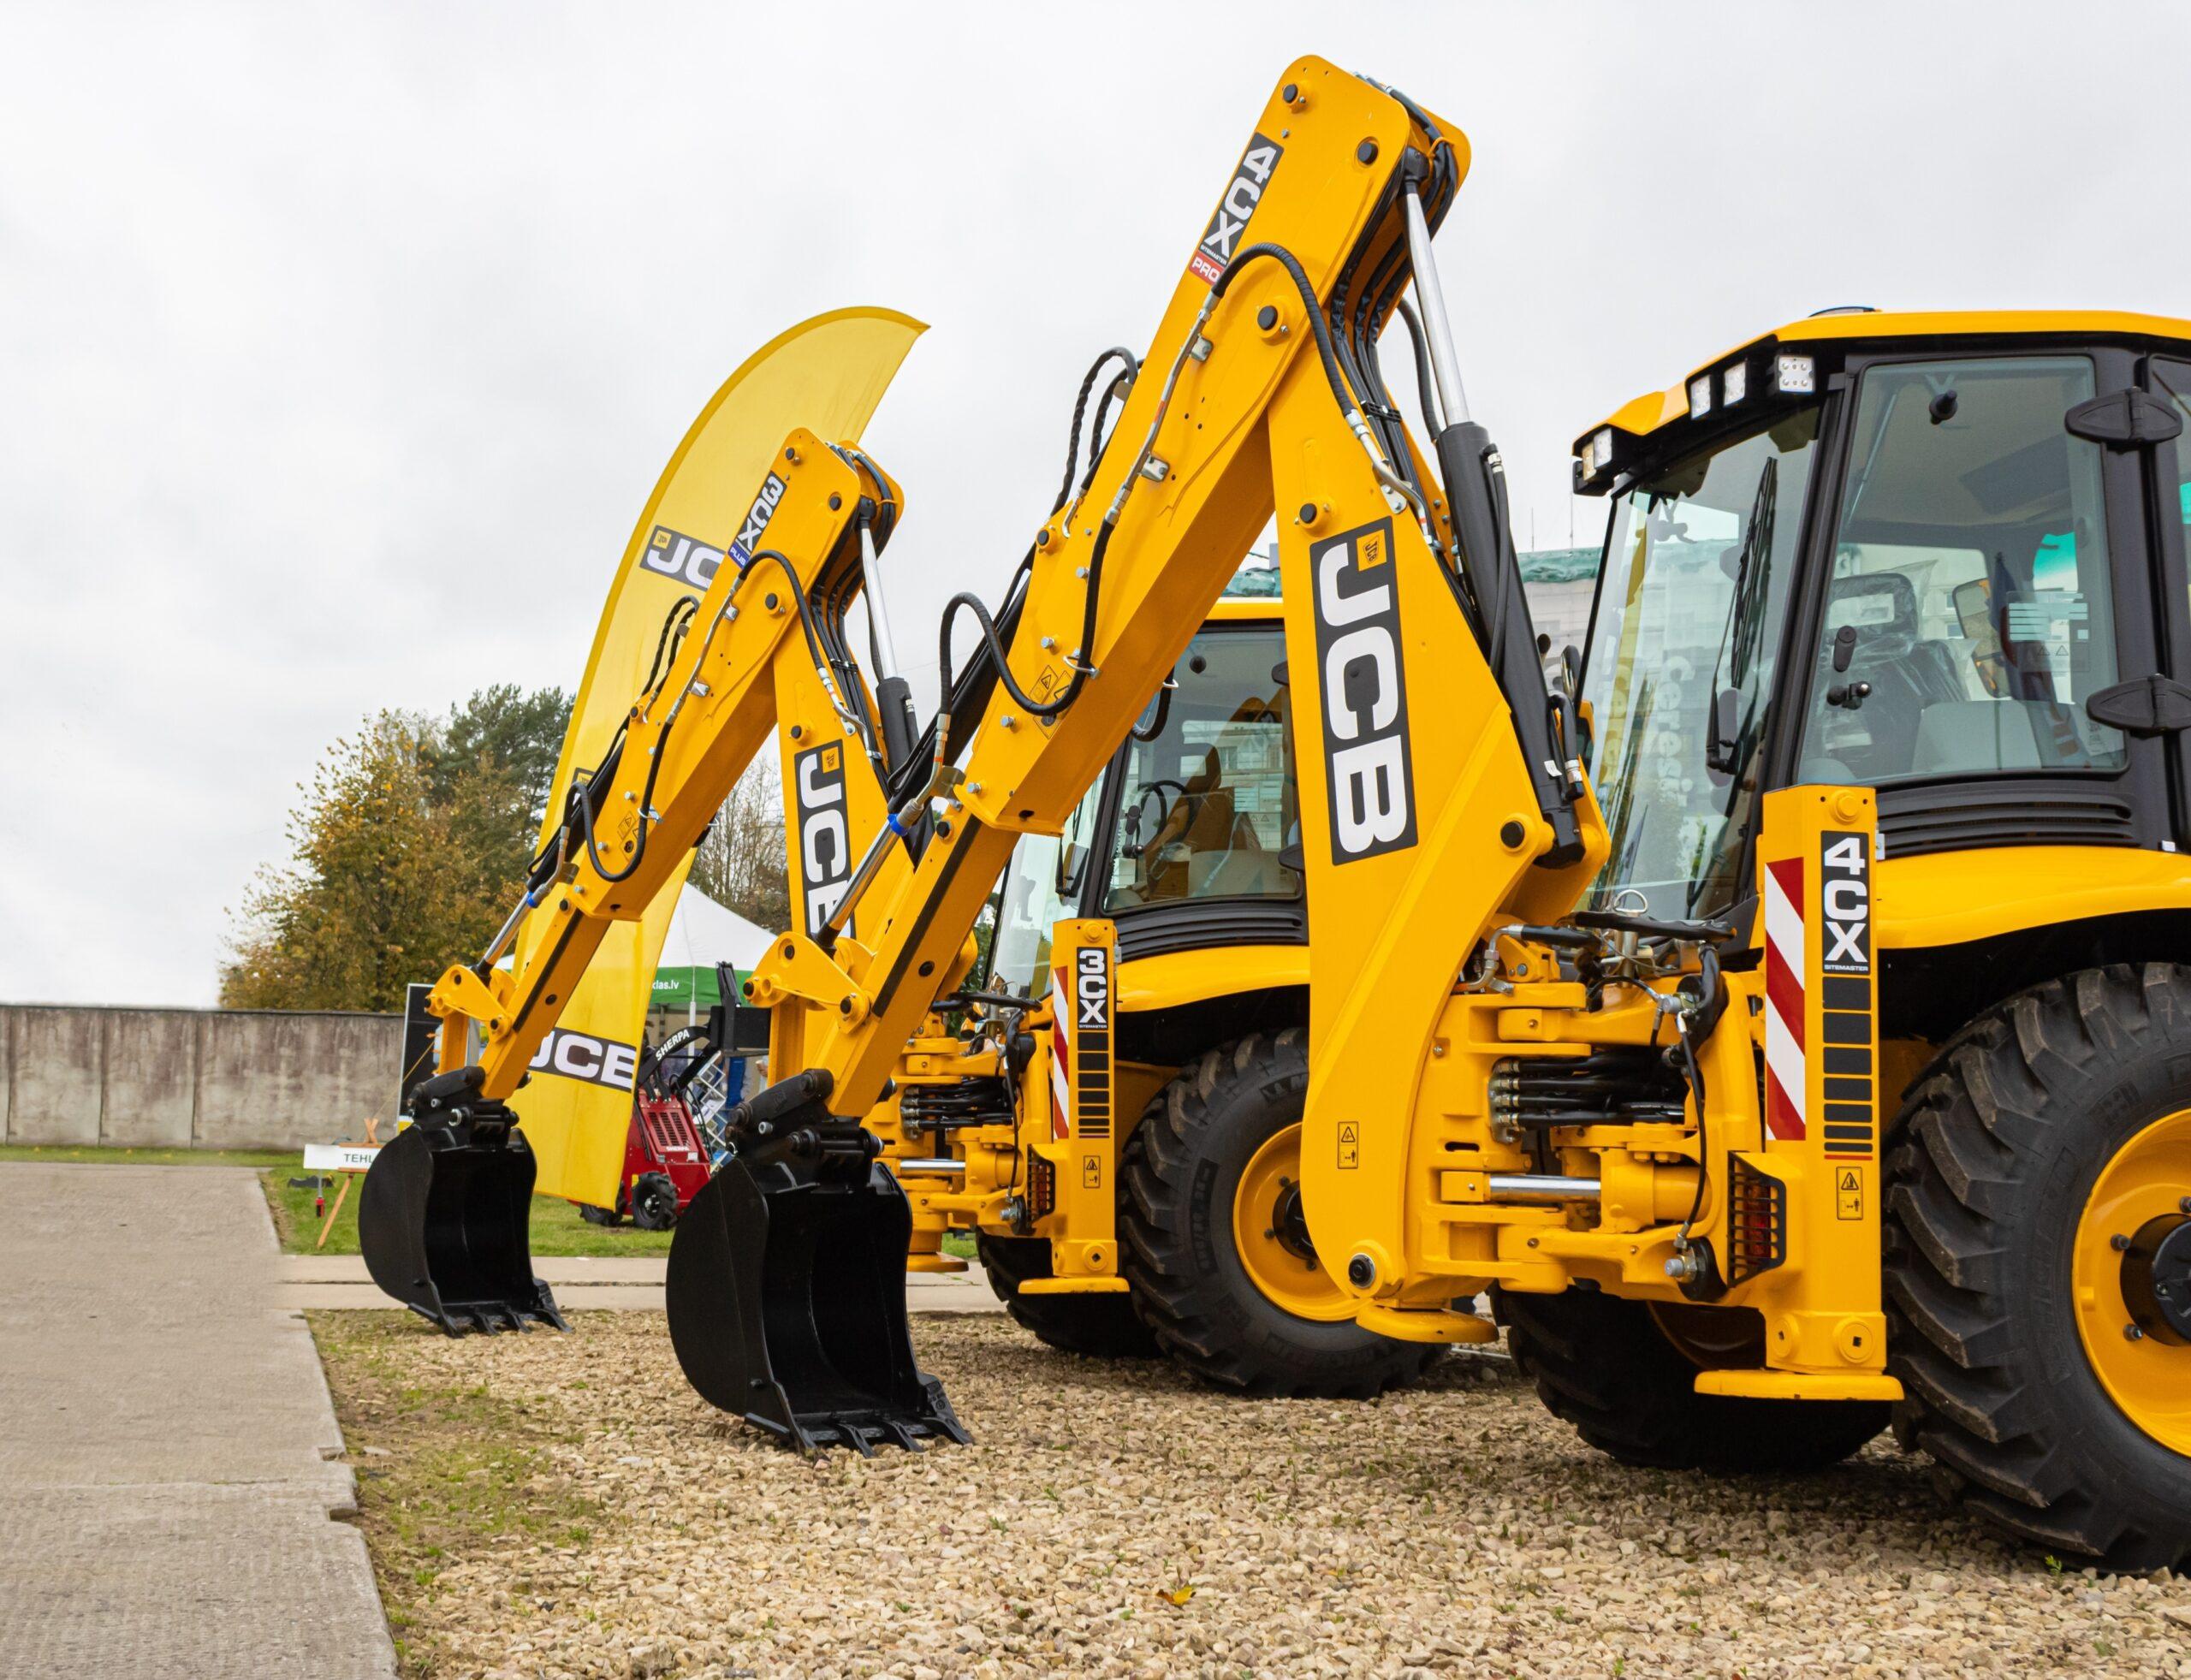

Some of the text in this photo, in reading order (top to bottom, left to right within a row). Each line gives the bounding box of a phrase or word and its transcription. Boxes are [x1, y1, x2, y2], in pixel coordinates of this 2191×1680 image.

[1203, 145, 1277, 258] 4CX
[1191, 256, 1221, 283] PRO
[737, 476, 784, 552] 3CX
[730, 546, 746, 567] PLUS
[1319, 542, 1407, 853] JCB
[1824, 837, 1868, 963] 4CX
[1078, 949, 1107, 1024] 3CX
[1824, 964, 1869, 972] SITEMASTER
[656, 1029, 690, 1061] SHERPA
